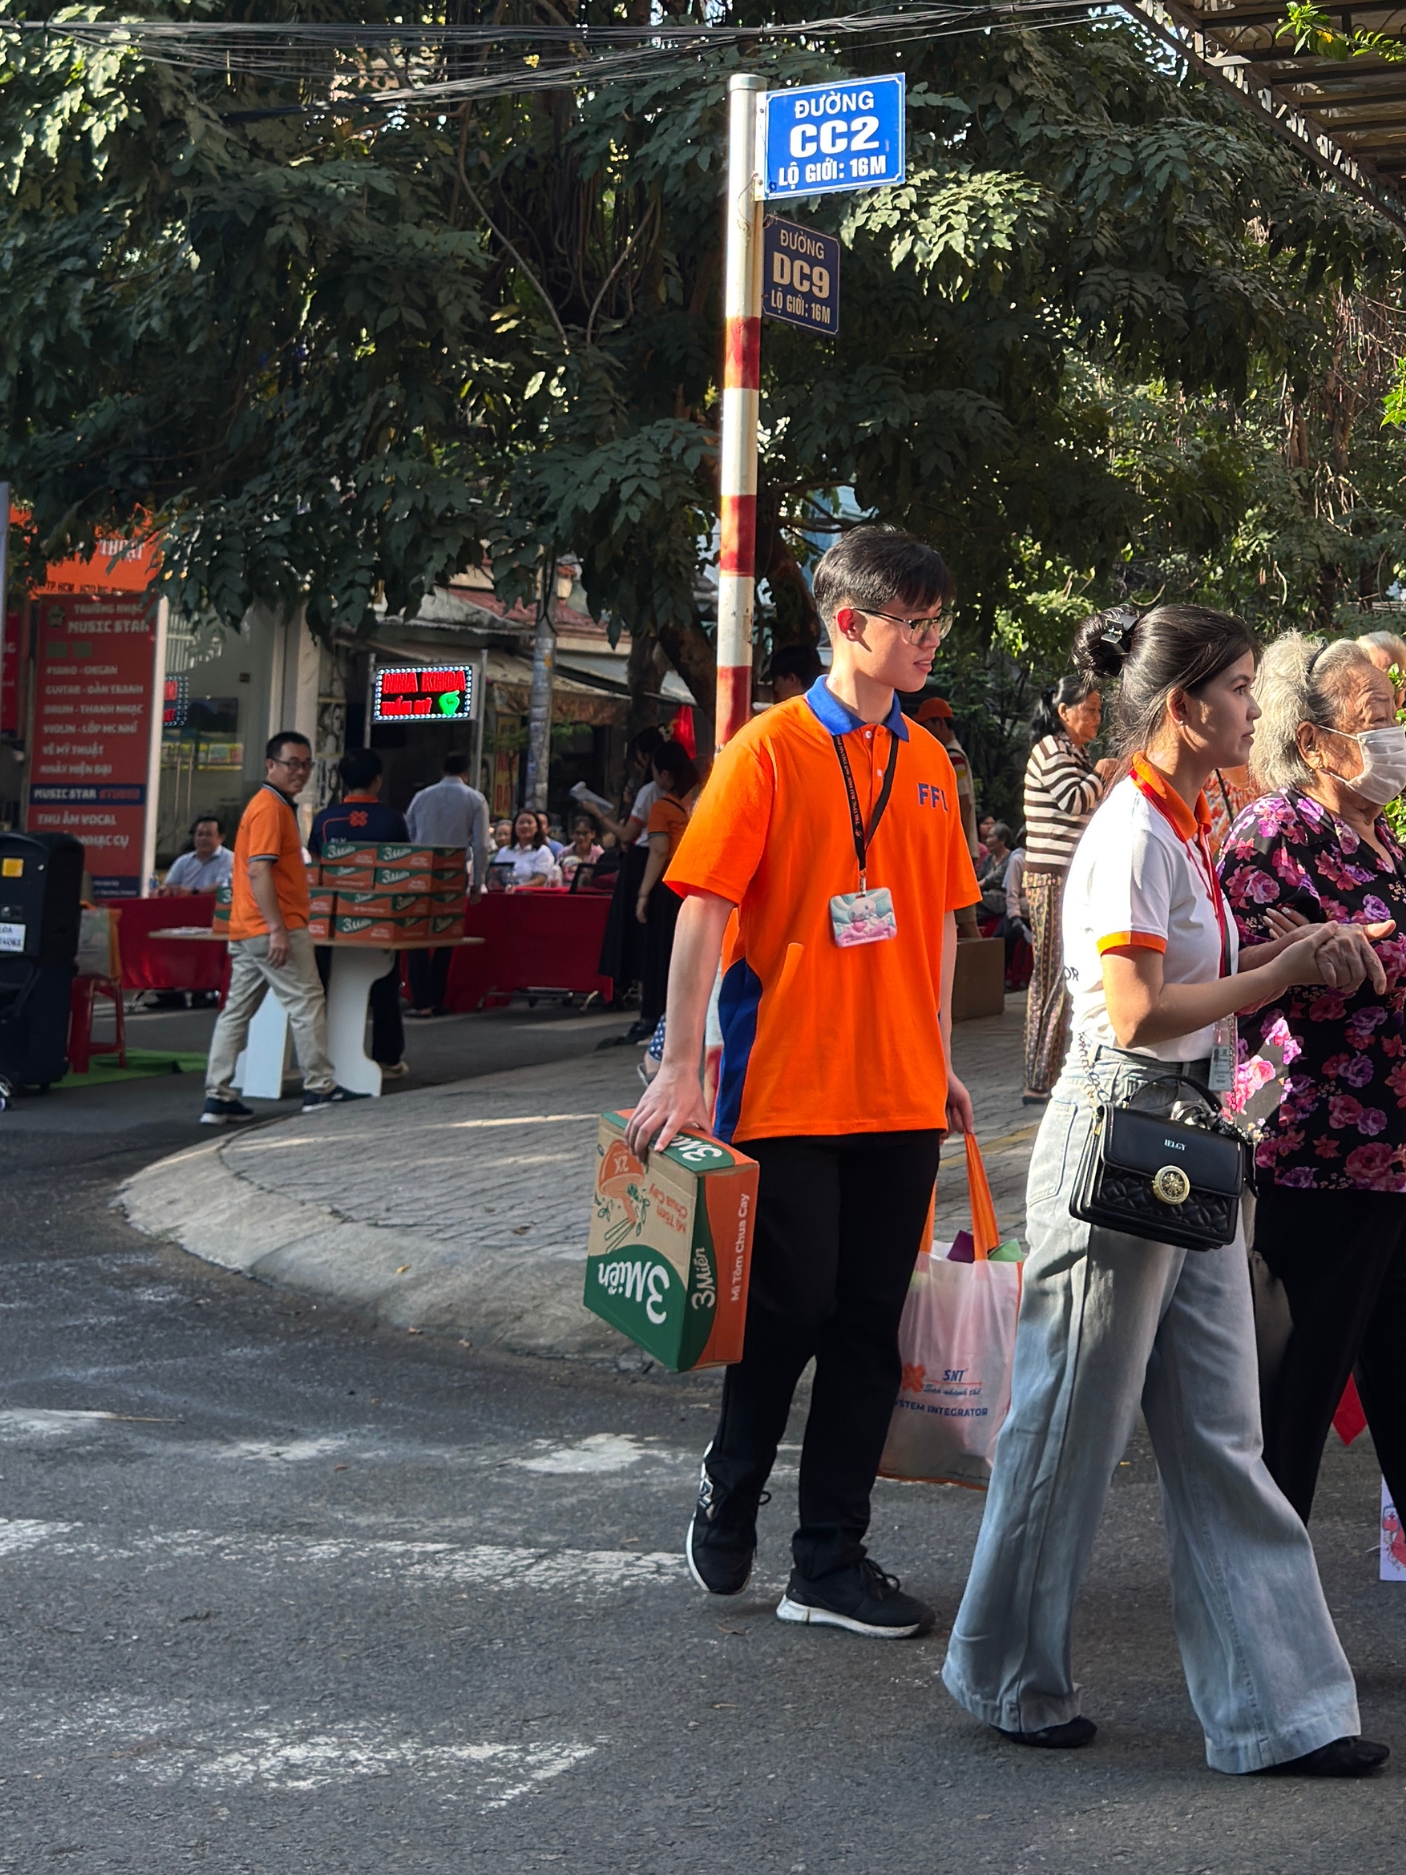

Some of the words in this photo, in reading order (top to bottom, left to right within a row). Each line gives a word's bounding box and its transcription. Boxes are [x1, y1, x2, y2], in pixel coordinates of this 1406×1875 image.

[794, 91, 875, 119] ĐƯỜNG
[789, 116, 880, 158] CC2
[778, 161, 800, 190] LỘ
[805, 157, 845, 183] GIỚI:
[849, 155, 887, 176] 16M
[779, 229, 825, 260] ĐƯỜNG
[772, 251, 830, 299] DC9
[770, 287, 784, 314] LỘ
[810, 303, 831, 324] 16M
[67, 620, 112, 634] MUSIC
[738, 1193, 750, 1218] Cay
[735, 1219, 747, 1253] Chua
[732, 1255, 743, 1283] Tôm
[943, 1369, 966, 1382] SNT
[927, 1405, 988, 1417] INTEGRATOR
